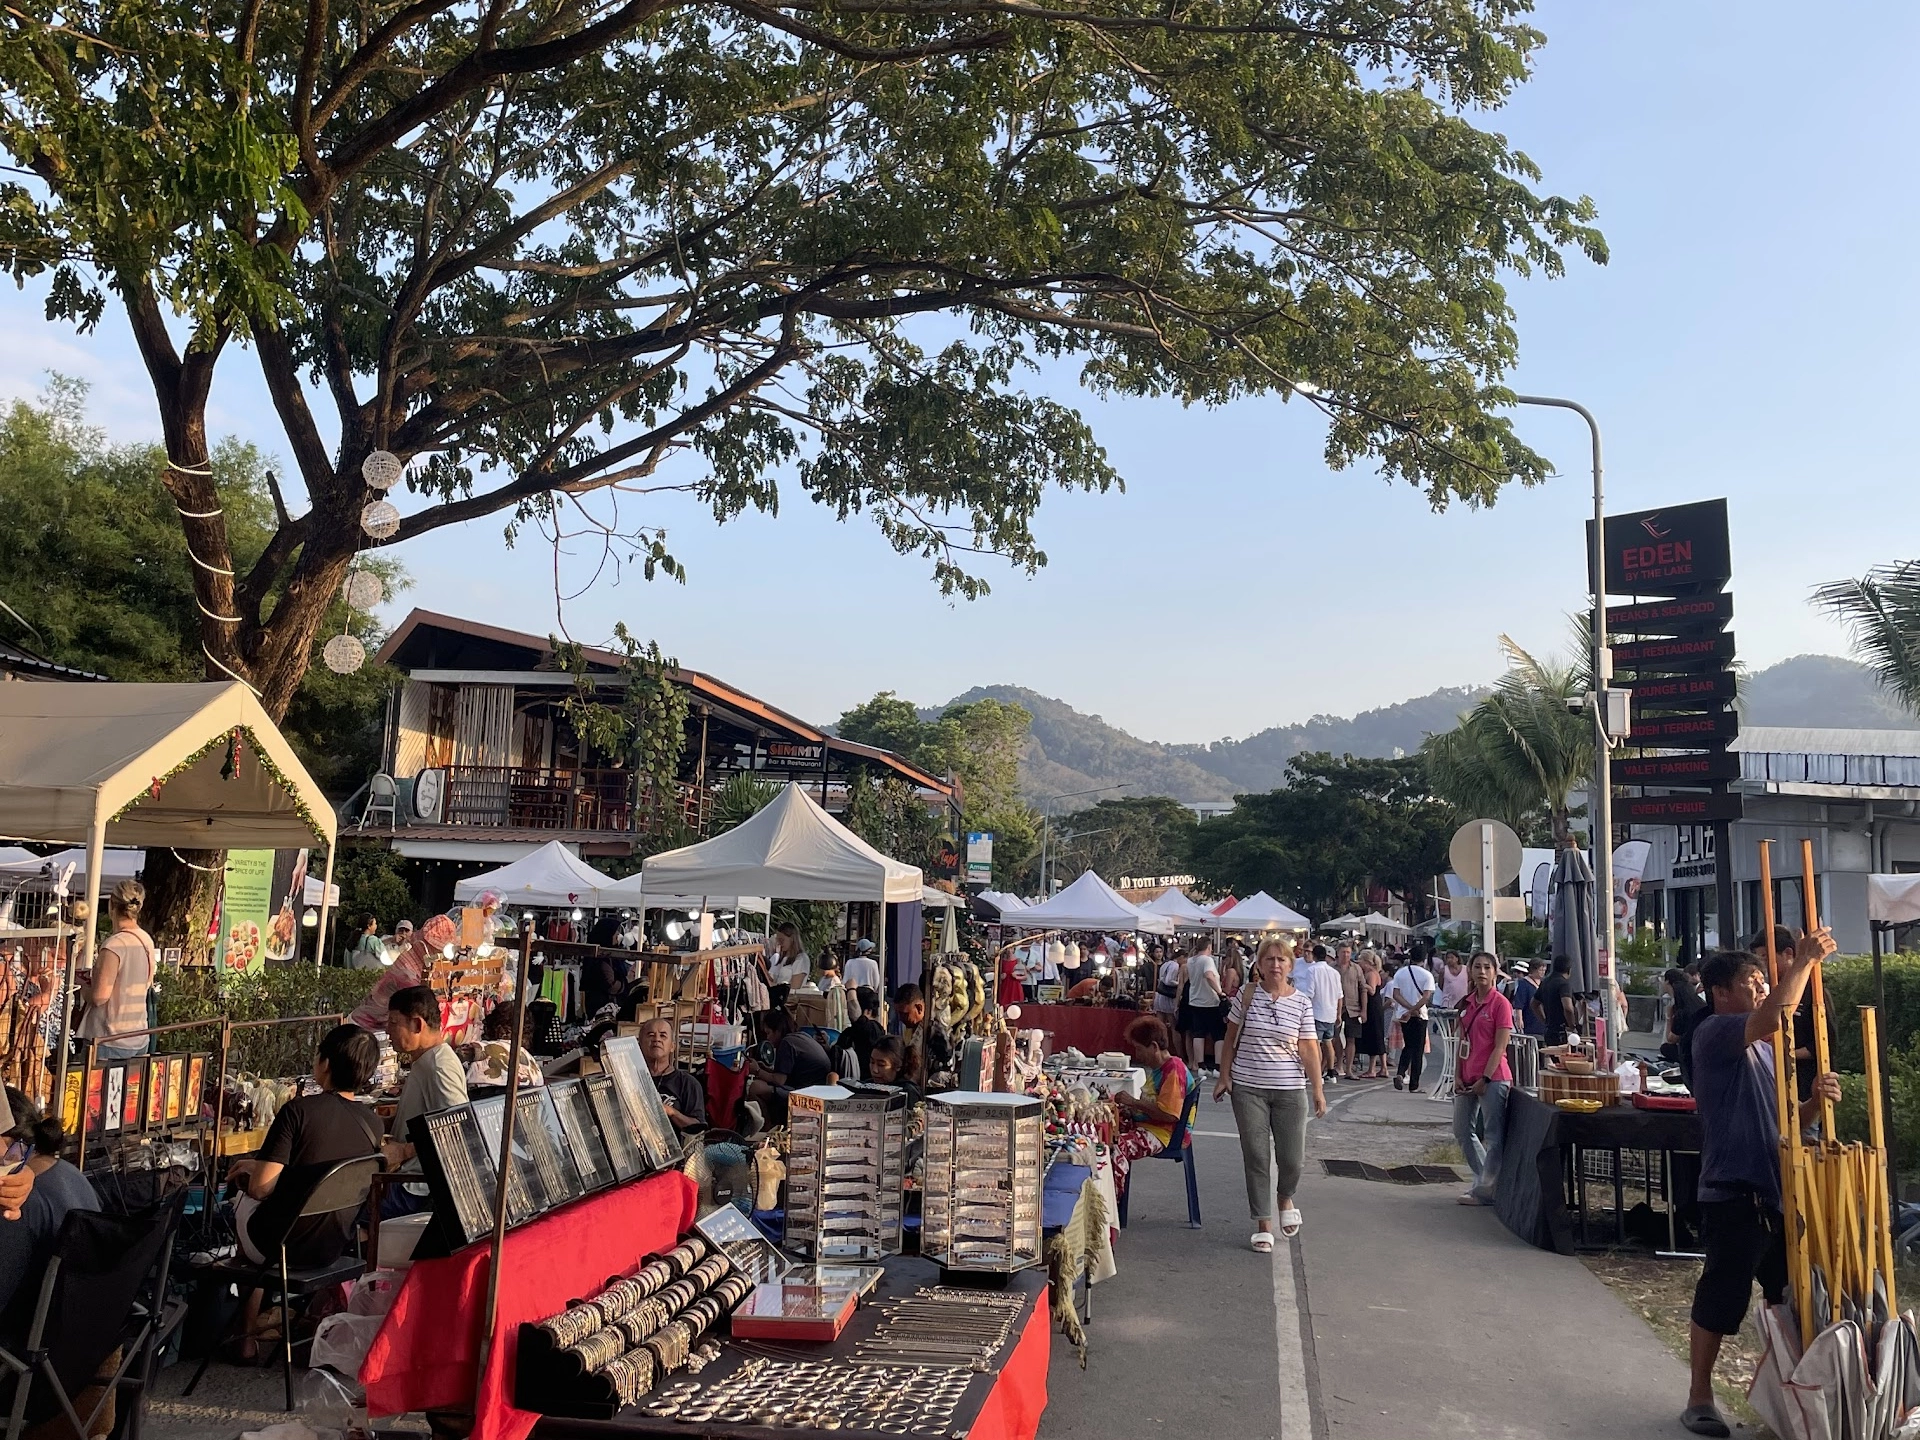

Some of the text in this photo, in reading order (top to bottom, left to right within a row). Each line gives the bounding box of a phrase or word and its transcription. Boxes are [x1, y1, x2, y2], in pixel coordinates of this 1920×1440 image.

[1622, 540, 1692, 570] EDEN
[1625, 564, 1692, 582] BY THE LAKE
[1608, 601, 1715, 623] STEAKS & SEAFOOD
[1643, 641, 1715, 658] RESTAURANT
[1632, 681, 1714, 698] LOUNGE & BAR
[1630, 720, 1715, 736] RDEN TERRACE
[770, 743, 823, 758] SIMMY
[1624, 761, 1710, 775] VALET PARKING
[1631, 801, 1706, 815] EVENT VENUE
[1132, 877, 1156, 888] TOTTI
[1160, 875, 1196, 887] SEAFOOD
